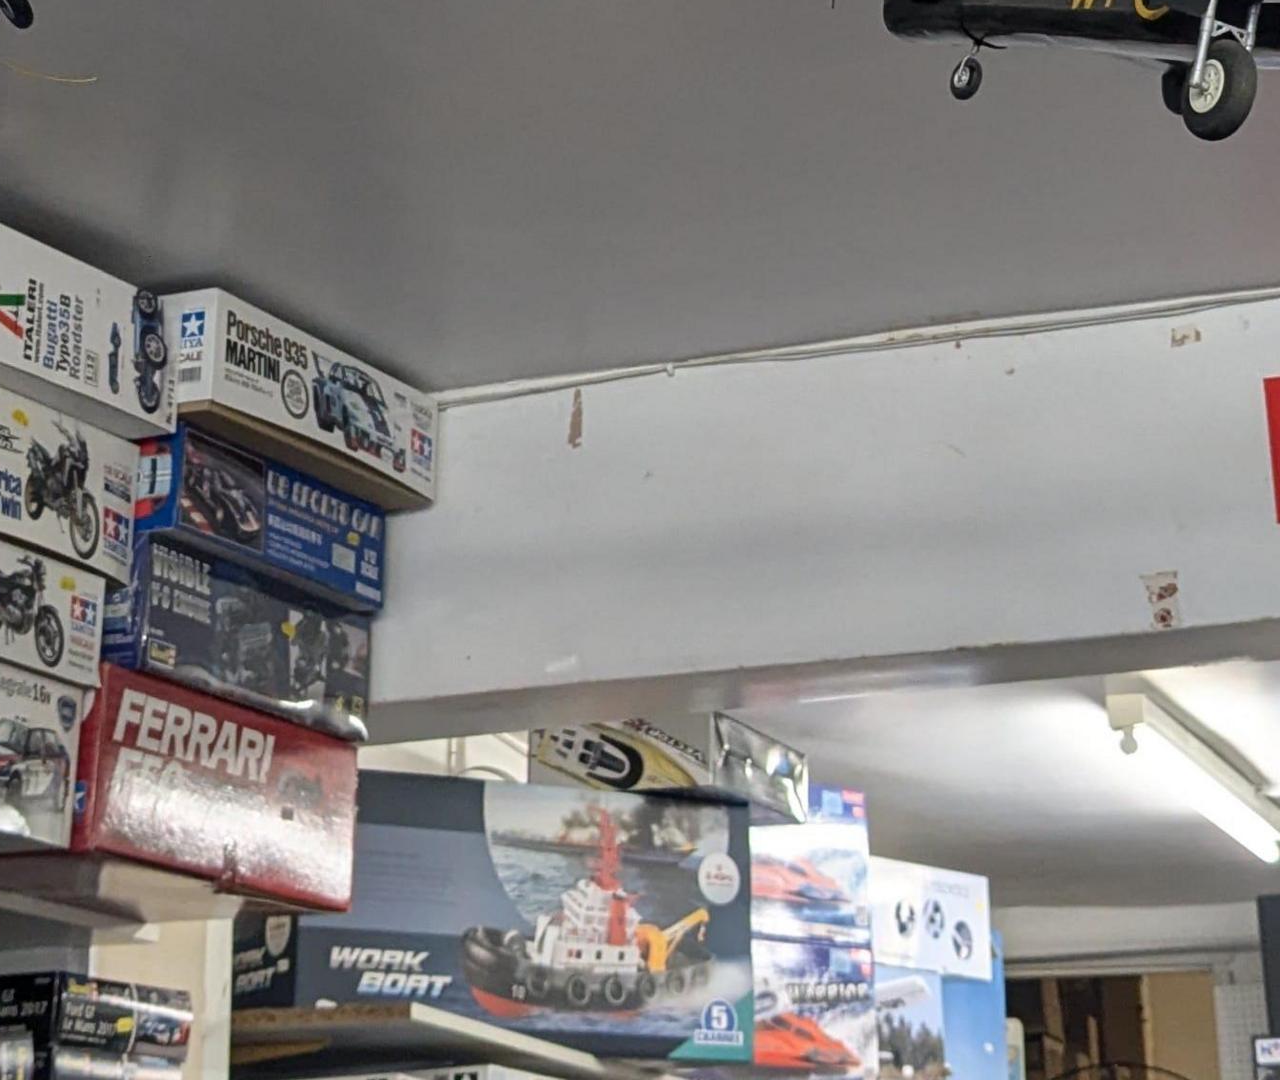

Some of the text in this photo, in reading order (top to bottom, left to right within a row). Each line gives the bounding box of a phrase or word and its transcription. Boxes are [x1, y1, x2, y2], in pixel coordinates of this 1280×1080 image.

[24, 278, 38, 361] ITALERI
[43, 299, 59, 370] Bugatti
[70, 295, 85, 381] Roadster
[225, 309, 308, 370] Porsche 935
[224, 338, 281, 385] MARTINI
[112, 687, 276, 784] FERRARI
[328, 944, 431, 972] WORK
[356, 970, 453, 999] BOAT
[708, 1005, 728, 1031] 5
